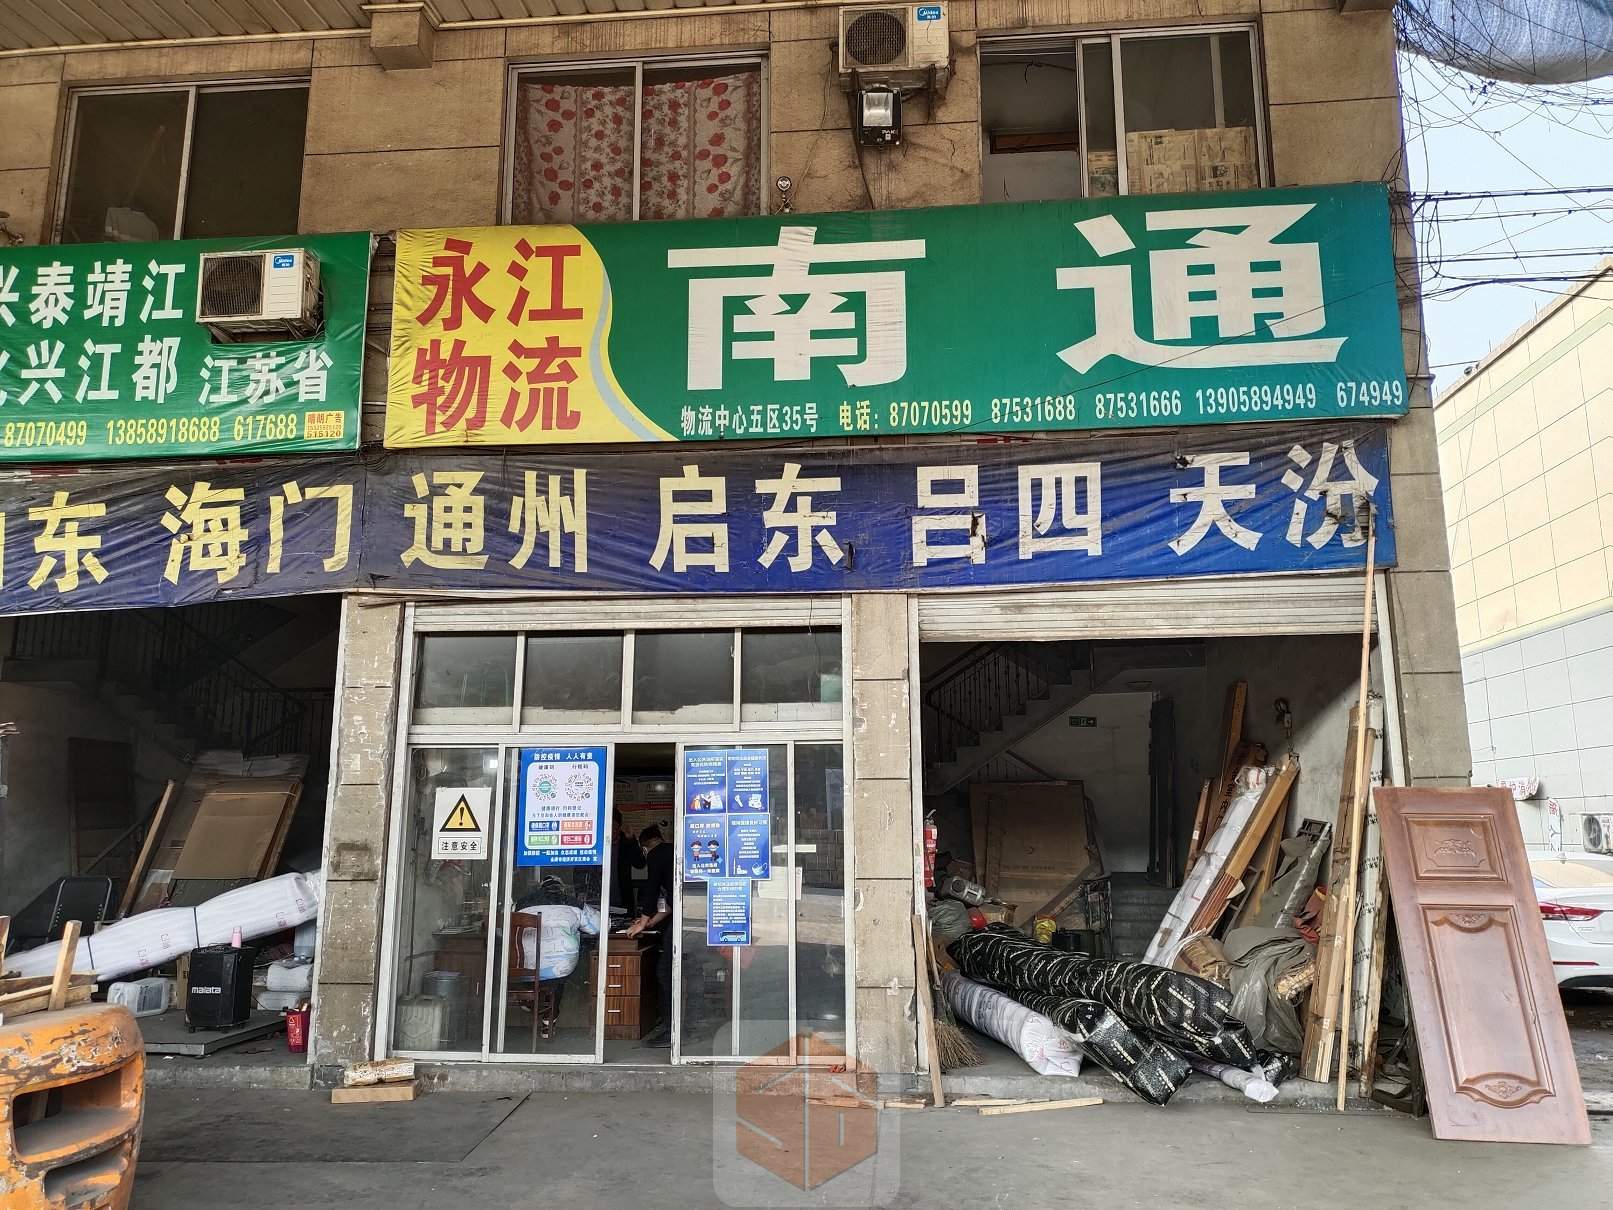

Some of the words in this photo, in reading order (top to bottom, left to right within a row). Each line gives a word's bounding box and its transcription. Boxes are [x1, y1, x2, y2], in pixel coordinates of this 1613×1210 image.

[415, 238, 584, 332] 永江
[668, 203, 1349, 391] 南通
[0, 334, 182, 406] 兴江都
[199, 349, 335, 406] 江苏省
[411, 336, 583, 435] 物流
[4, 420, 88, 448] 87070499
[106, 417, 221, 446] 13858918688
[233, 413, 298, 442] 617688
[681, 402, 819, 436] 物流中心五区35号
[889, 400, 973, 427] 87070599
[991, 394, 1076, 424] 87531688
[1095, 389, 1182, 419] 87531666
[1195, 383, 1317, 414] 13905894949
[1336, 379, 1404, 407] 674949
[0, 490, 110, 593] 东
[160, 480, 354, 586] 海门
[400, 467, 588, 574] 通州
[649, 462, 845, 574] 启东
[912, 462, 1102, 567] 吕四
[441, 841, 478, 851] 注意安全
[191, 986, 222, 994] malata
